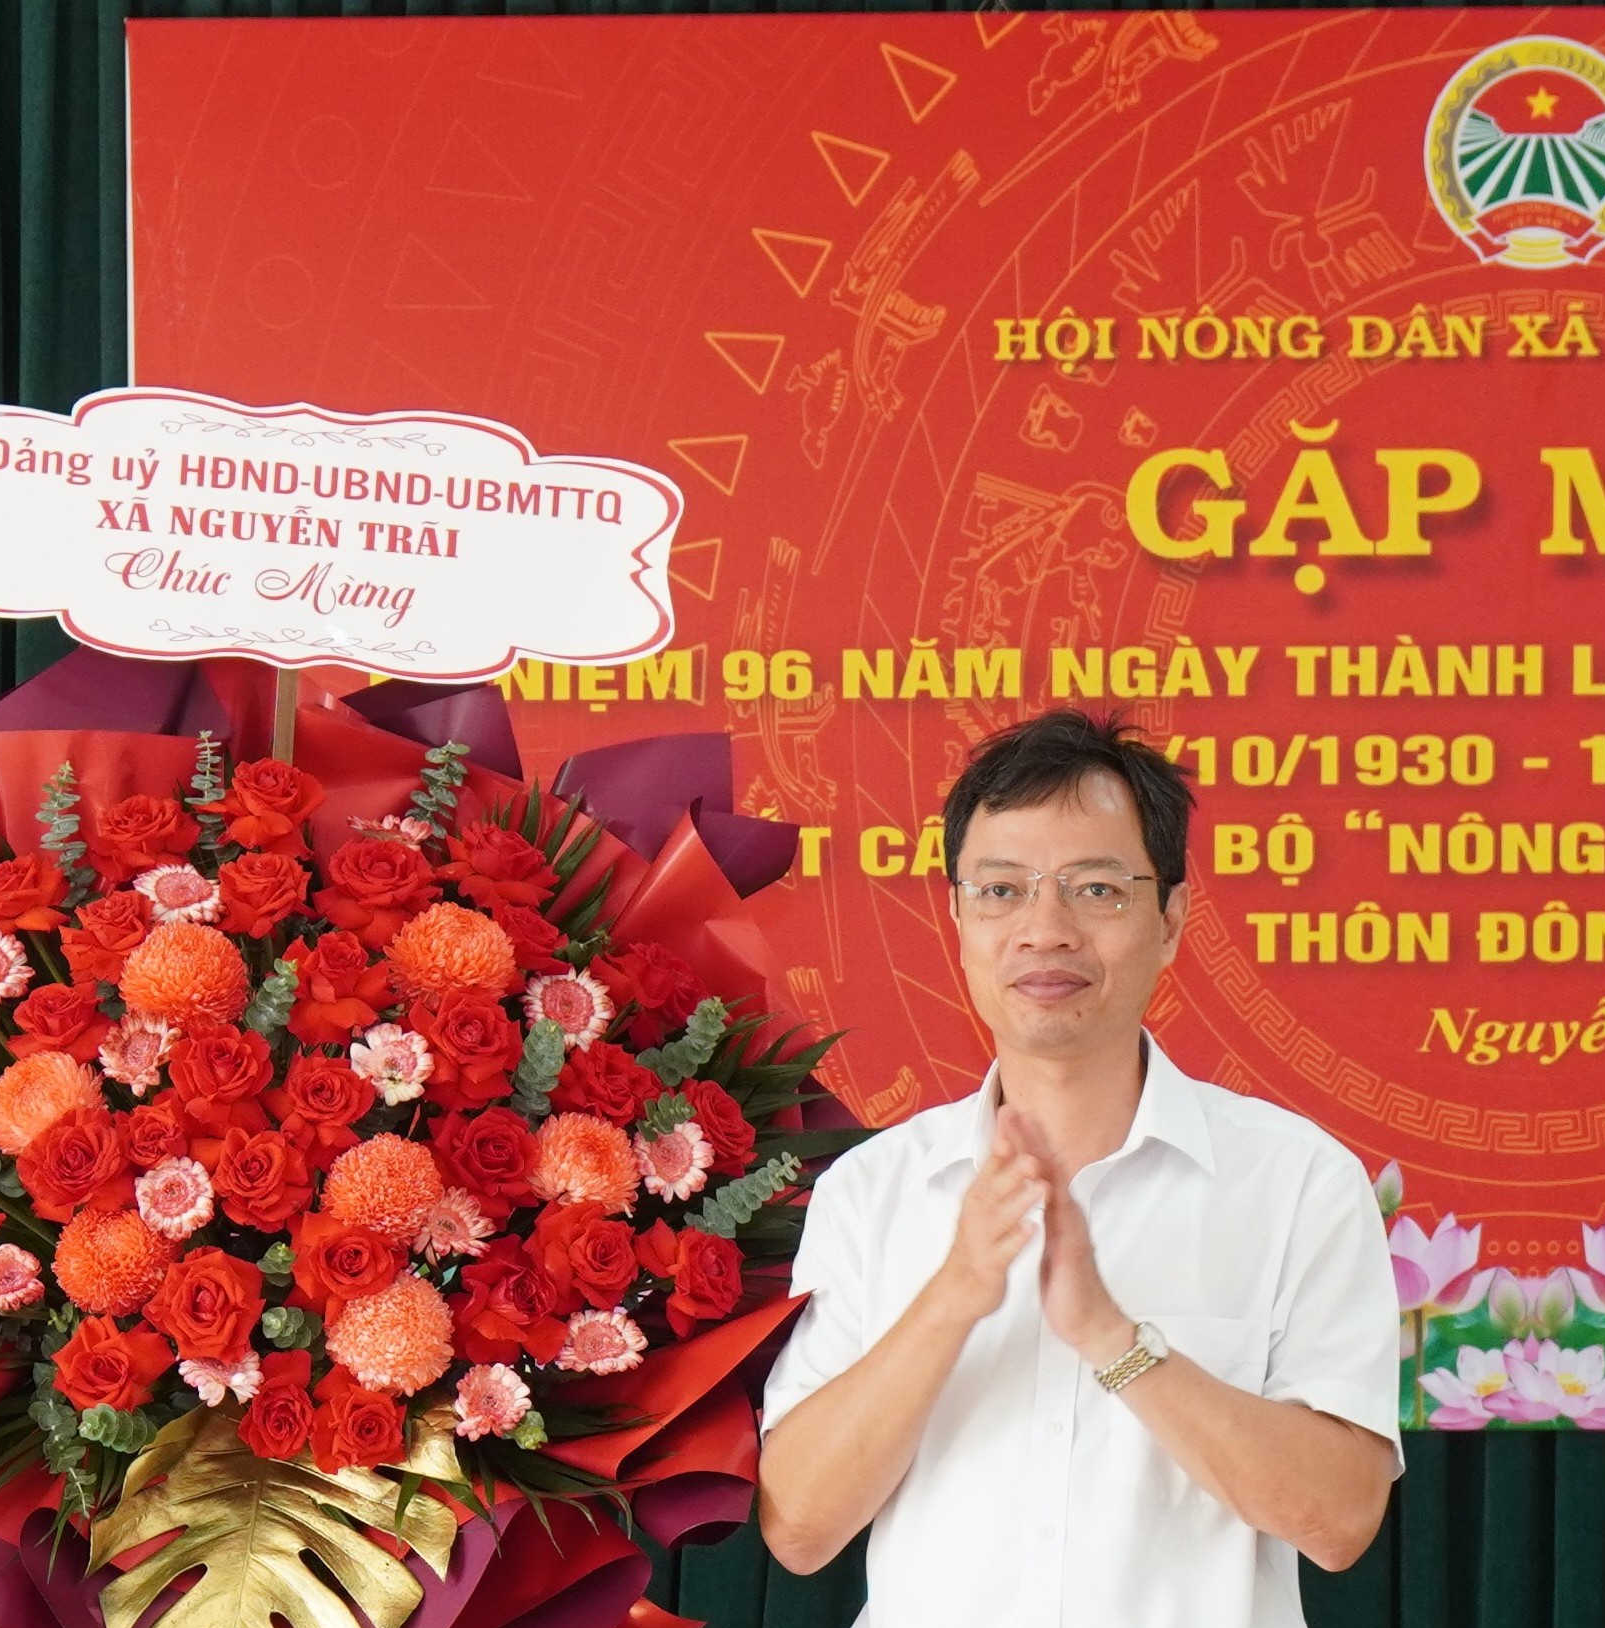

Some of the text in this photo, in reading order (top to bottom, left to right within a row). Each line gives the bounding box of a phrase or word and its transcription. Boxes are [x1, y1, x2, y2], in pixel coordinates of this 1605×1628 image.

[994, 306, 1115, 374] HỘI
[1138, 305, 1324, 359] NÔNG
[1348, 304, 1486, 358] DÂN
[1508, 302, 1598, 356] XÃ
[111, 447, 160, 491] uỷ
[179, 453, 624, 526] HĐND-UBND-UBMTTQ
[1125, 419, 1480, 594] GẶP
[96, 496, 460, 560] XÃ NGUYỄN TRÃI
[104, 547, 416, 629] Chúc Mừng
[722, 649, 813, 701] 96
[842, 637, 1022, 699] NĂM
[1051, 635, 1259, 698] NGÀY
[1285, 635, 1543, 696] THÀNH
[859, 815, 947, 877] CÂ
[1214, 813, 1314, 886] BỘ
[1246, 901, 1449, 963] THÔN
